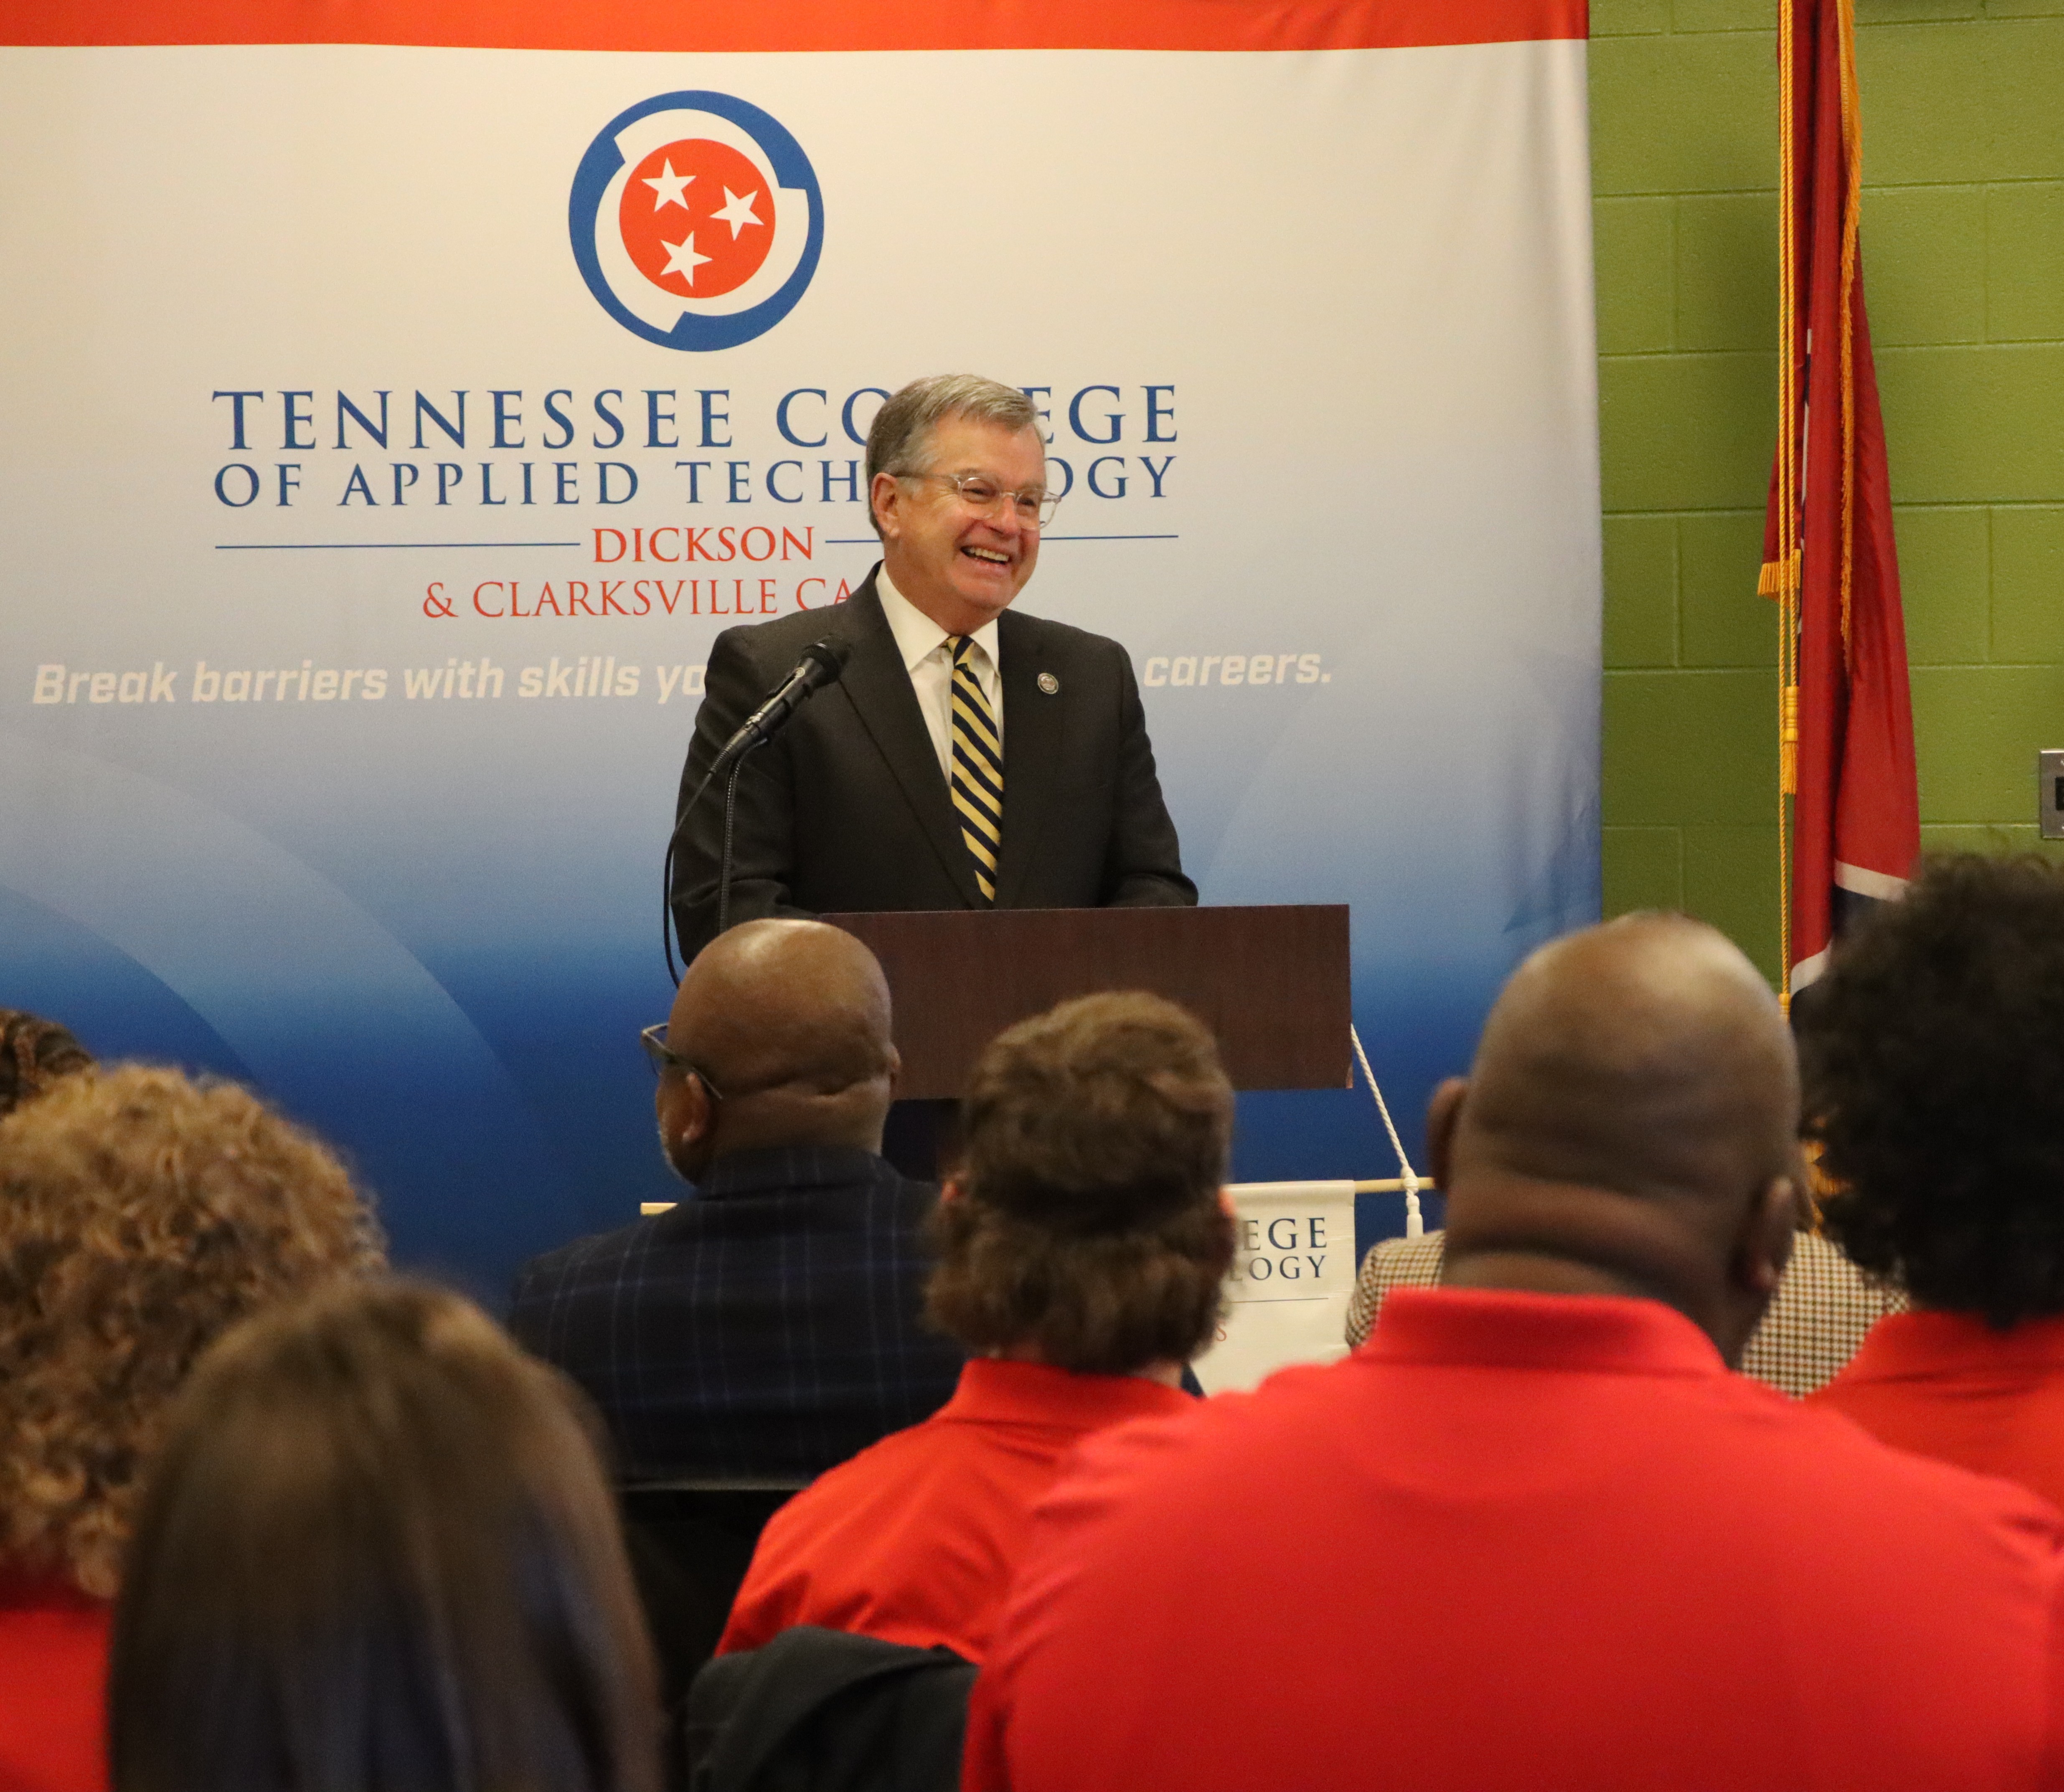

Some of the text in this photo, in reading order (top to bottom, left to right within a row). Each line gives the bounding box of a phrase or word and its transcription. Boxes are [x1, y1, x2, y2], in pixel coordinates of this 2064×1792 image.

[213, 385, 1177, 449] TENNESSEE COEGE
[214, 456, 1177, 507] OF APPLIED TECHOGY
[592, 526, 815, 563] DICKSON
[423, 582, 458, 618] &
[473, 579, 778, 618] CLARKSVILLE
[32, 653, 1331, 705] Break barriers with skills yo careers.
[1242, 1217, 1327, 1251] EGE
